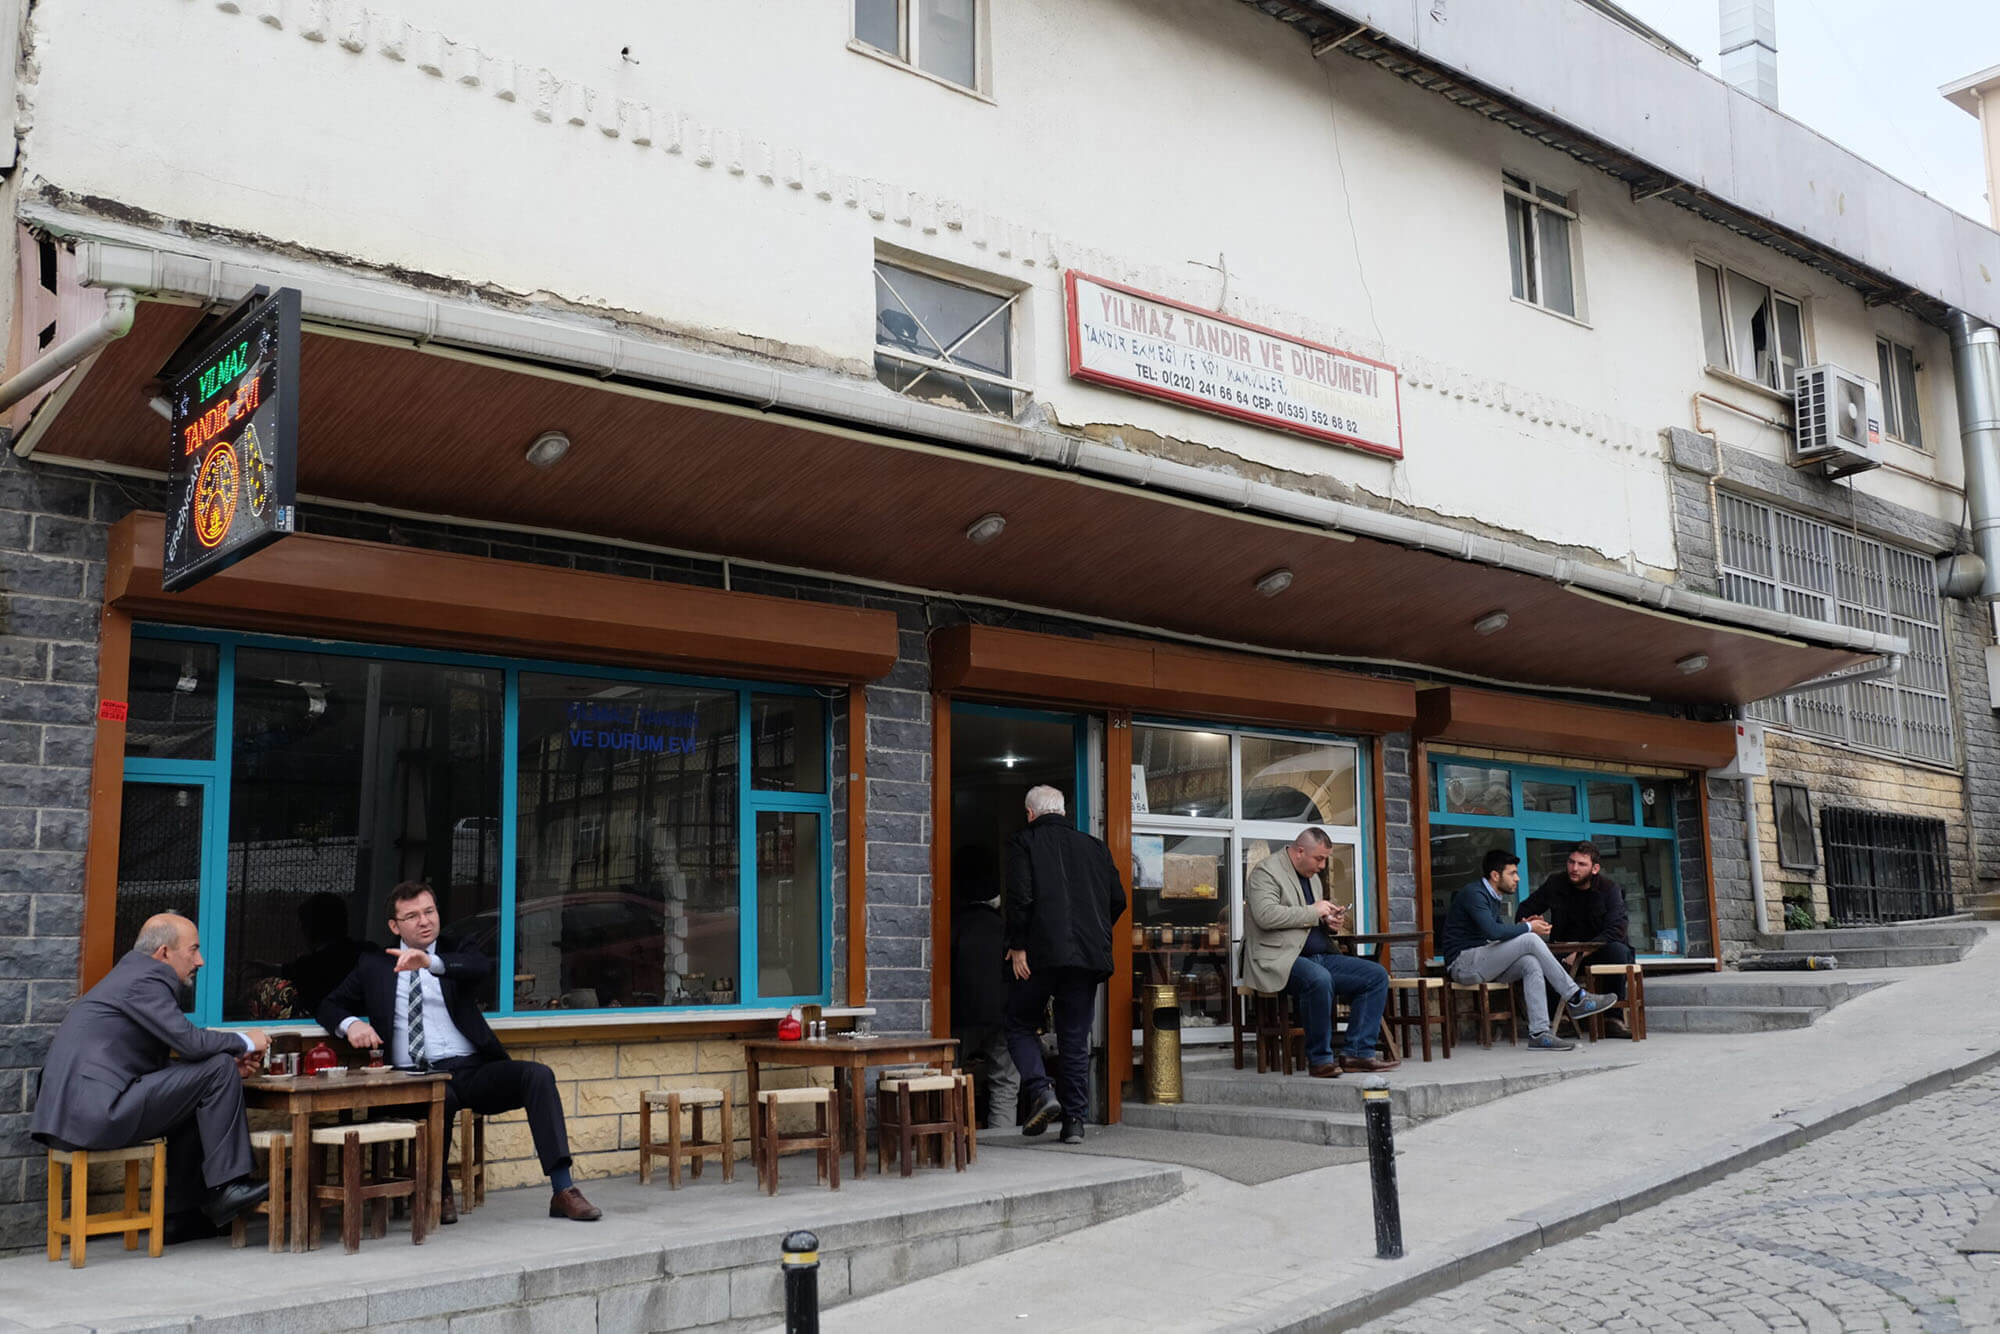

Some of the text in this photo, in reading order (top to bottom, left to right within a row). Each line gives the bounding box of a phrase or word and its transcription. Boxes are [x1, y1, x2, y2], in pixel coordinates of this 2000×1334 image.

[1083, 323, 1127, 352] TANDIR
[1100, 292, 1177, 342] YILMAZ
[1183, 317, 1252, 364] TANDIR
[1258, 339, 1284, 373] VE
[1291, 346, 1379, 399] DÜRÜMEVİ
[199, 340, 249, 404] YILMAZ
[1135, 363, 1359, 434] TEL: 0(212) 241 66 64 CEP: 0(535) 552 68 82
[569, 728, 594, 748] VE
[597, 728, 664, 753] DÜRÜM
[1112, 718, 1128, 729] 24
